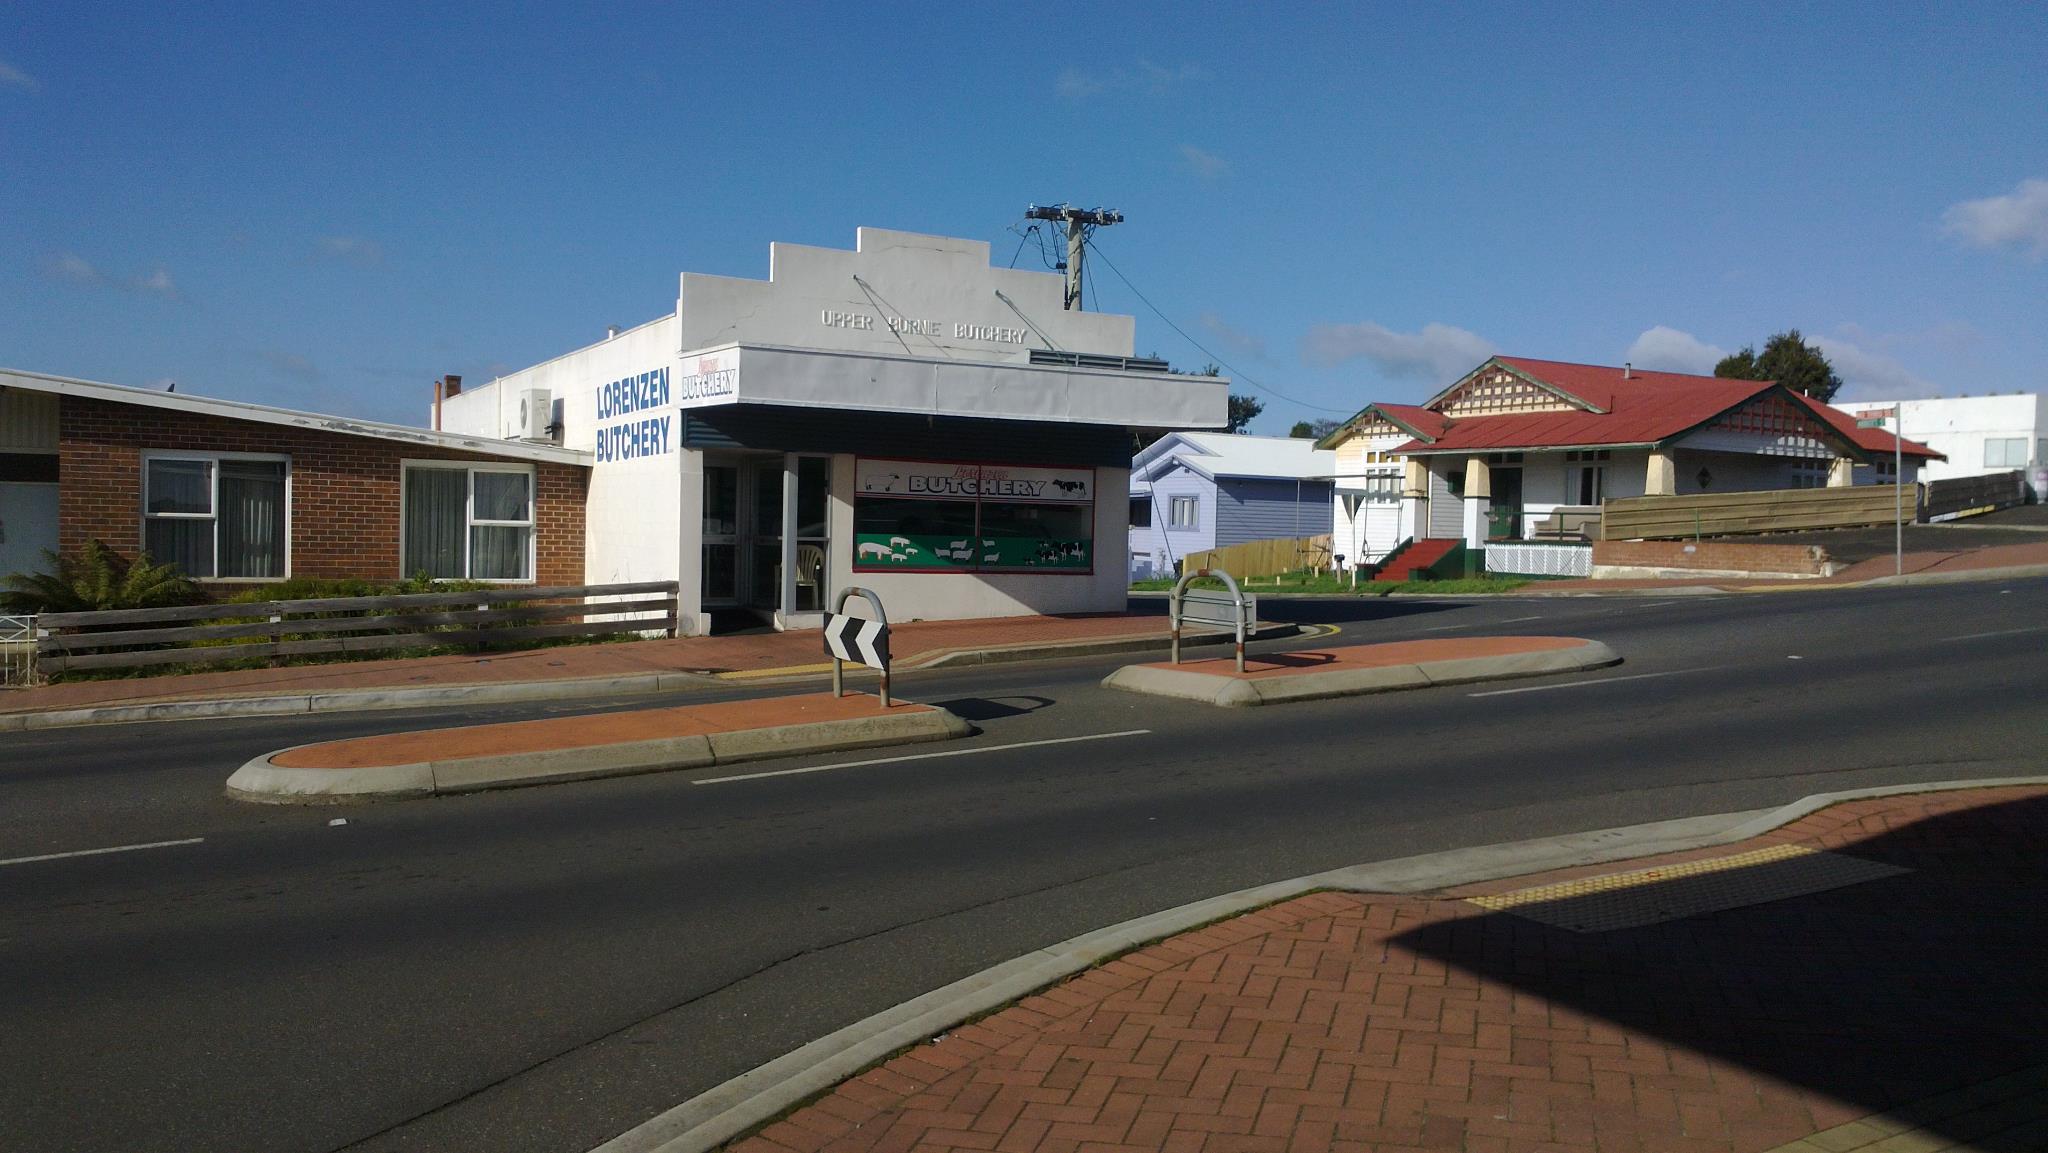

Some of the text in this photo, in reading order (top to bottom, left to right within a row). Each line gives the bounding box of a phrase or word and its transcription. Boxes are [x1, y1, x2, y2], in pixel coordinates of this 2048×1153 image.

[821, 310, 1028, 345] UPPER BURNIE BUTCHERY
[597, 366, 670, 420] LORENZEN
[682, 368, 736, 400] BUTCHERY
[597, 415, 671, 463] BUTCHERY
[909, 475, 1046, 497] BUTCHERY
